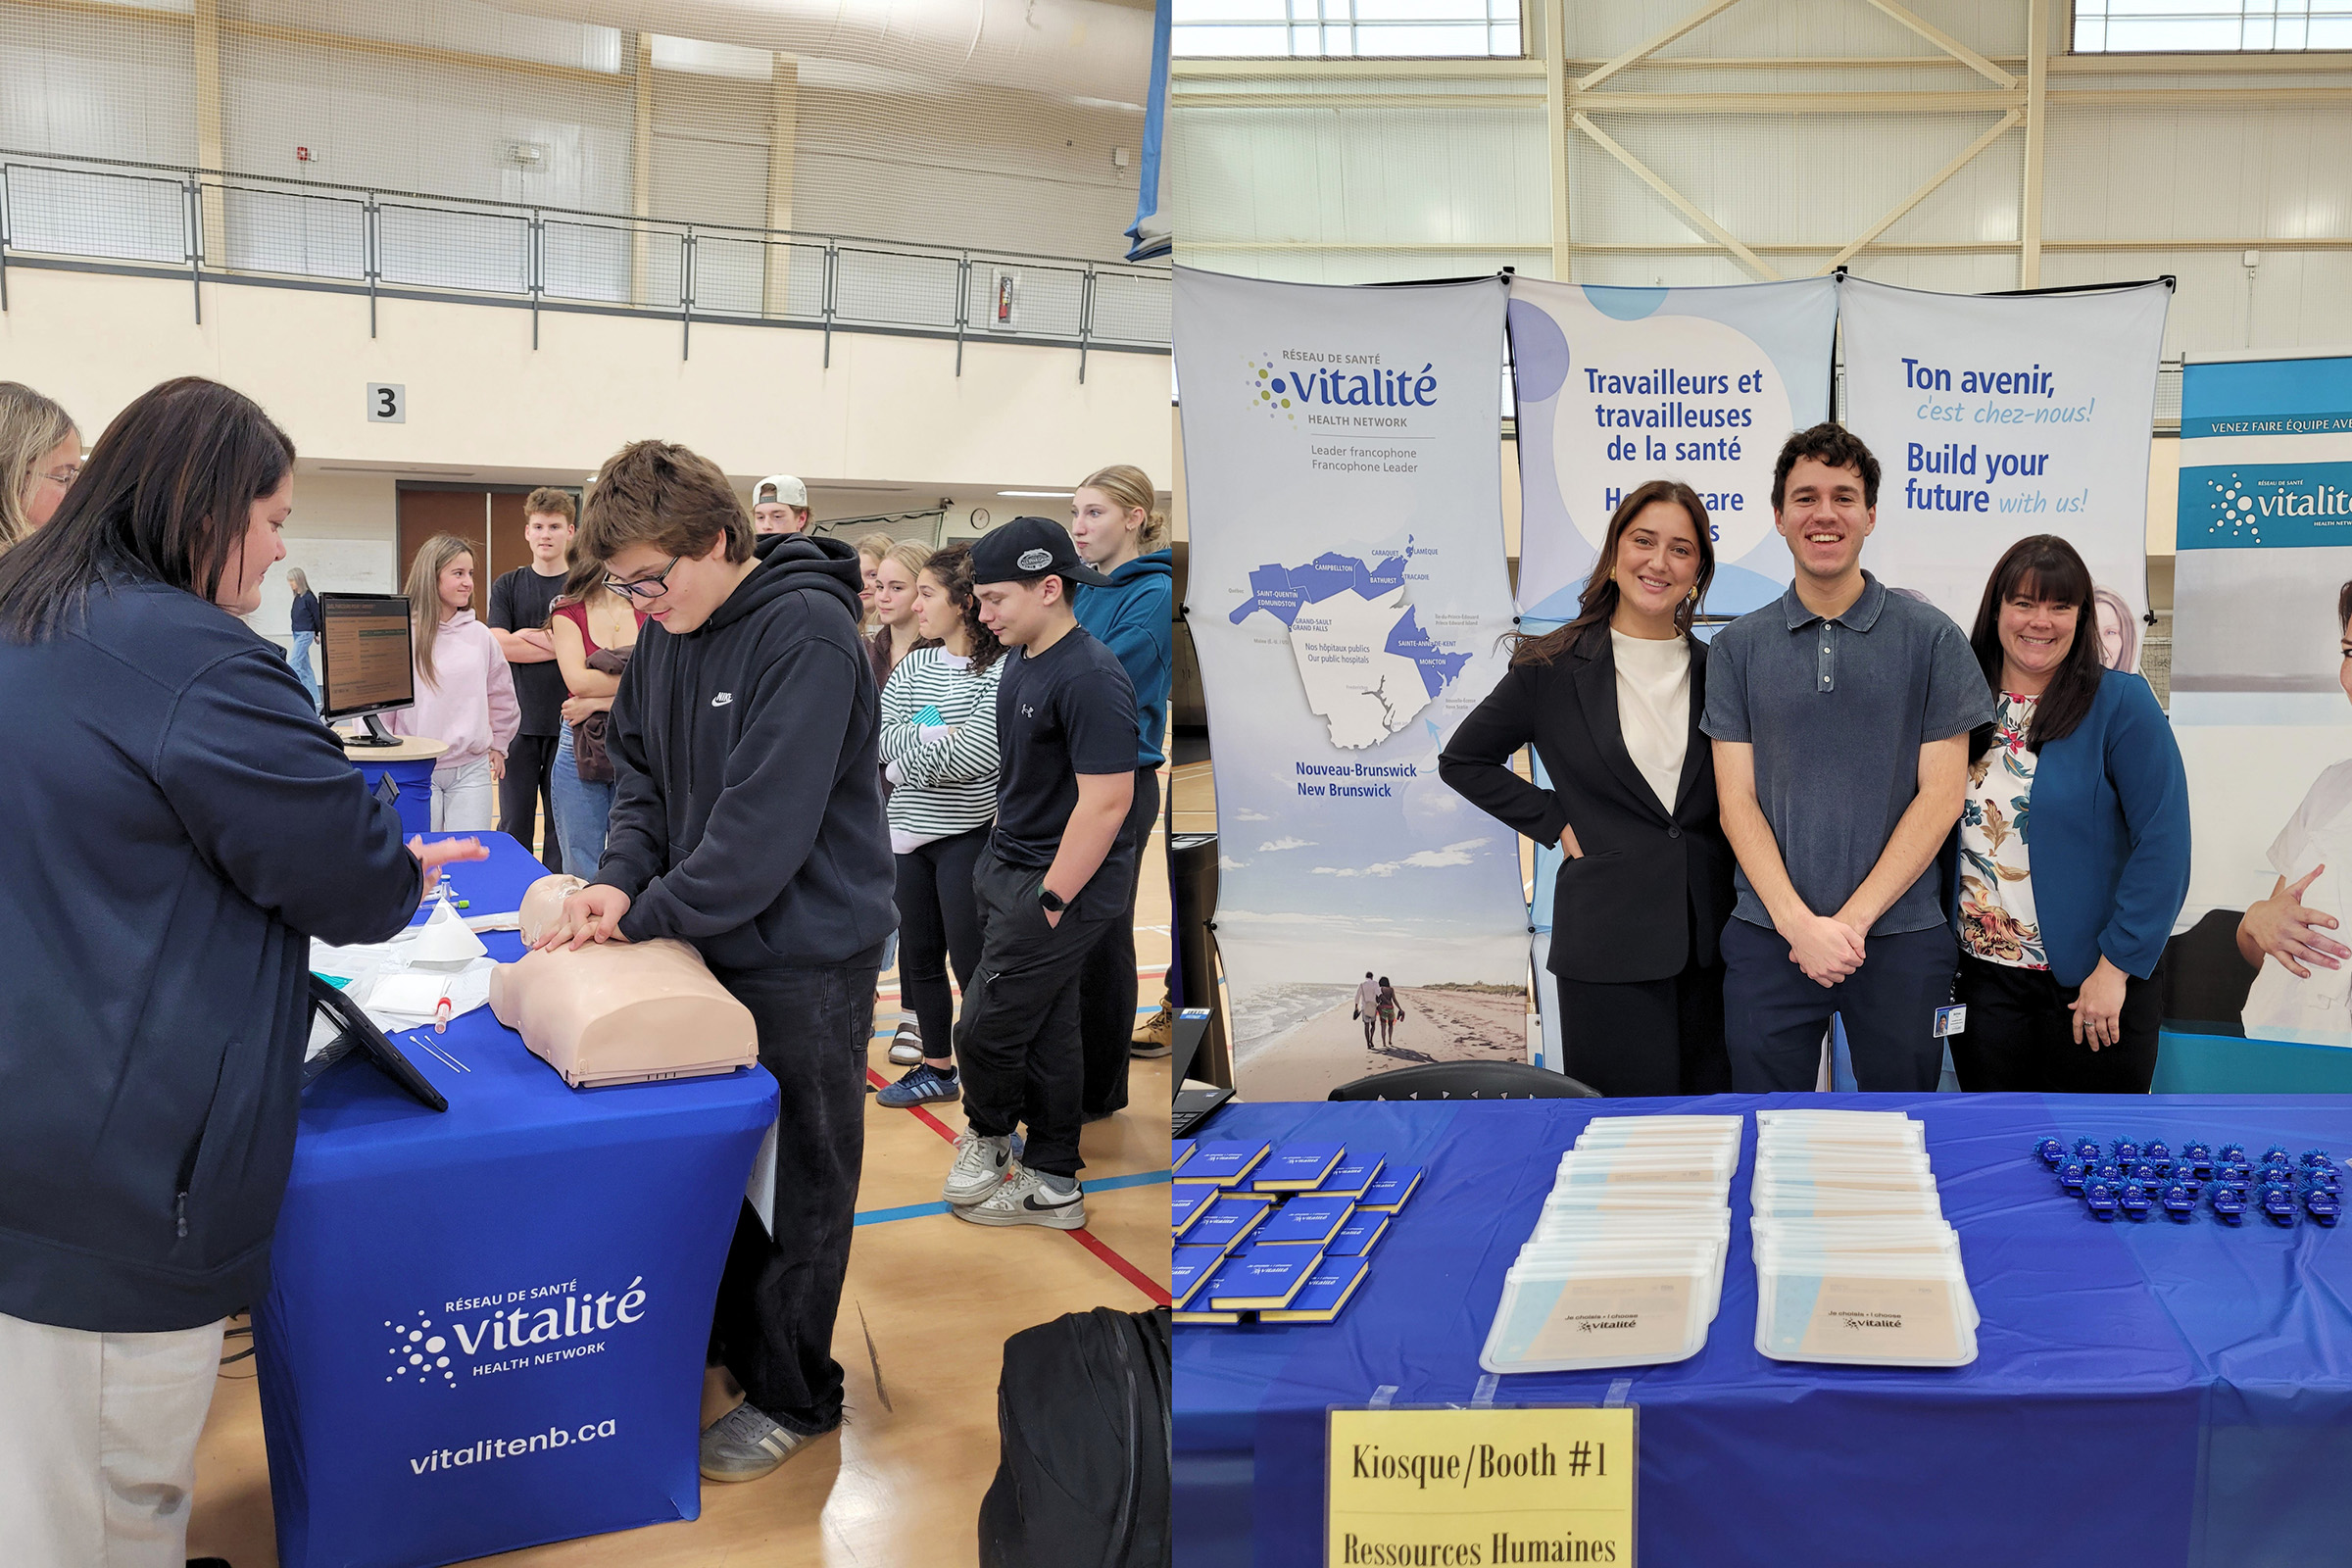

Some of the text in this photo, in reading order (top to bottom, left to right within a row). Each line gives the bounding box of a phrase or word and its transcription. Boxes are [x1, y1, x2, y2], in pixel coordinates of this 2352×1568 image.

[1282, 349, 1381, 366] RÉSEAU DE SANTÉ
[1289, 363, 1438, 407] vitalité
[1584, 368, 1763, 395] Travailleurs et
[1901, 357, 2055, 398] Ton avenir,
[377, 387, 396, 417] 3
[1917, 395, 2095, 423] c'est chez-nous!
[1307, 415, 1408, 427] HEALTH NETWORK
[1595, 402, 1752, 428] travailleuses
[2211, 422, 2249, 433] VENEZ
[2252, 420, 2283, 432] FAIRE
[2286, 418, 2329, 433] ÉQUIPE
[1311, 445, 1417, 462] Leader francophone
[1606, 435, 1741, 462] de la santé
[1312, 460, 1418, 473] Francophone Leader
[1907, 442, 2049, 484] Build your
[1905, 478, 2088, 514] future with us!
[2257, 485, 2352, 517] vitalit
[1413, 547, 1439, 557] LAMÈQUE
[1314, 564, 1353, 572] CAMPBELLTON
[1256, 589, 1298, 599] SAINT-QUENTIN
[1257, 599, 1297, 608] EDMUNDSTON
[1295, 617, 1333, 626] GRAND-SAULT
[1304, 642, 1370, 656] Nos hôpitaux publics
[1307, 654, 1369, 665] Our public hospitals
[715, 691, 732, 702] NIKE
[1296, 761, 1417, 777] Nouveau-Brunswick
[1298, 782, 1392, 798] New Brunswick
[445, 1278, 577, 1313] RÉSEAU DE SANTÉ
[452, 1275, 647, 1355] vitalité
[1857, 1319, 1902, 1328] vitalité
[1592, 1319, 1637, 1329] vitalité
[472, 1341, 606, 1377] HEALTH NETWORK
[410, 1418, 616, 1475] vitalitenb.ca
[1351, 1441, 1608, 1490] Kiosque/Booth #1
[1344, 1531, 1616, 1567] Ressources Humaines
